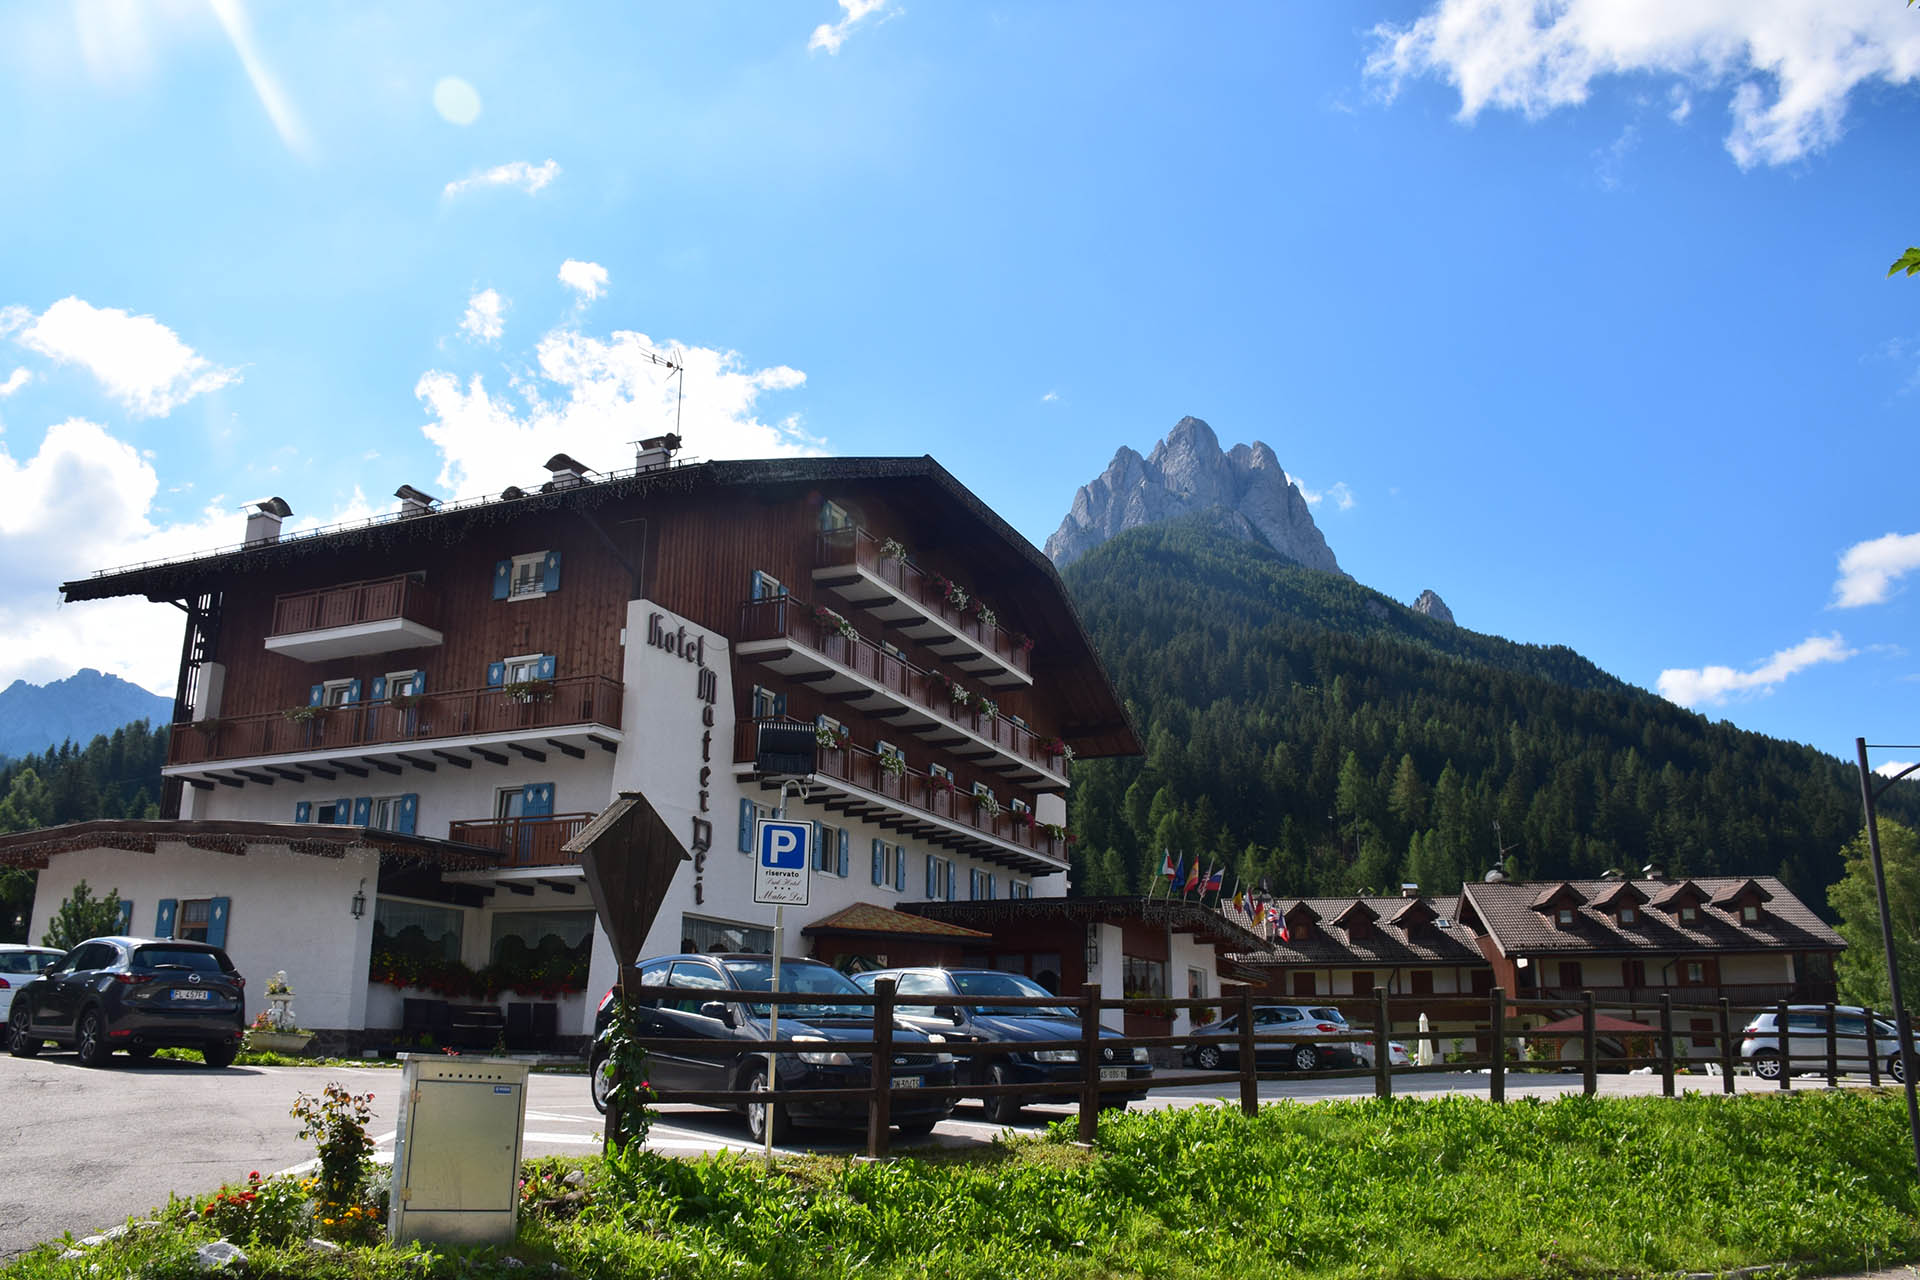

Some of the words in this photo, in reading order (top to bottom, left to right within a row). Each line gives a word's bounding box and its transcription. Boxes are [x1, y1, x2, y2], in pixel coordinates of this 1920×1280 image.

[697, 666, 718, 812] Mater
[691, 816, 712, 905] Dei
[770, 829, 797, 864] P
[765, 870, 800, 878] riservato
[763, 890, 786, 900] Mater
[789, 892, 803, 901] Dei
